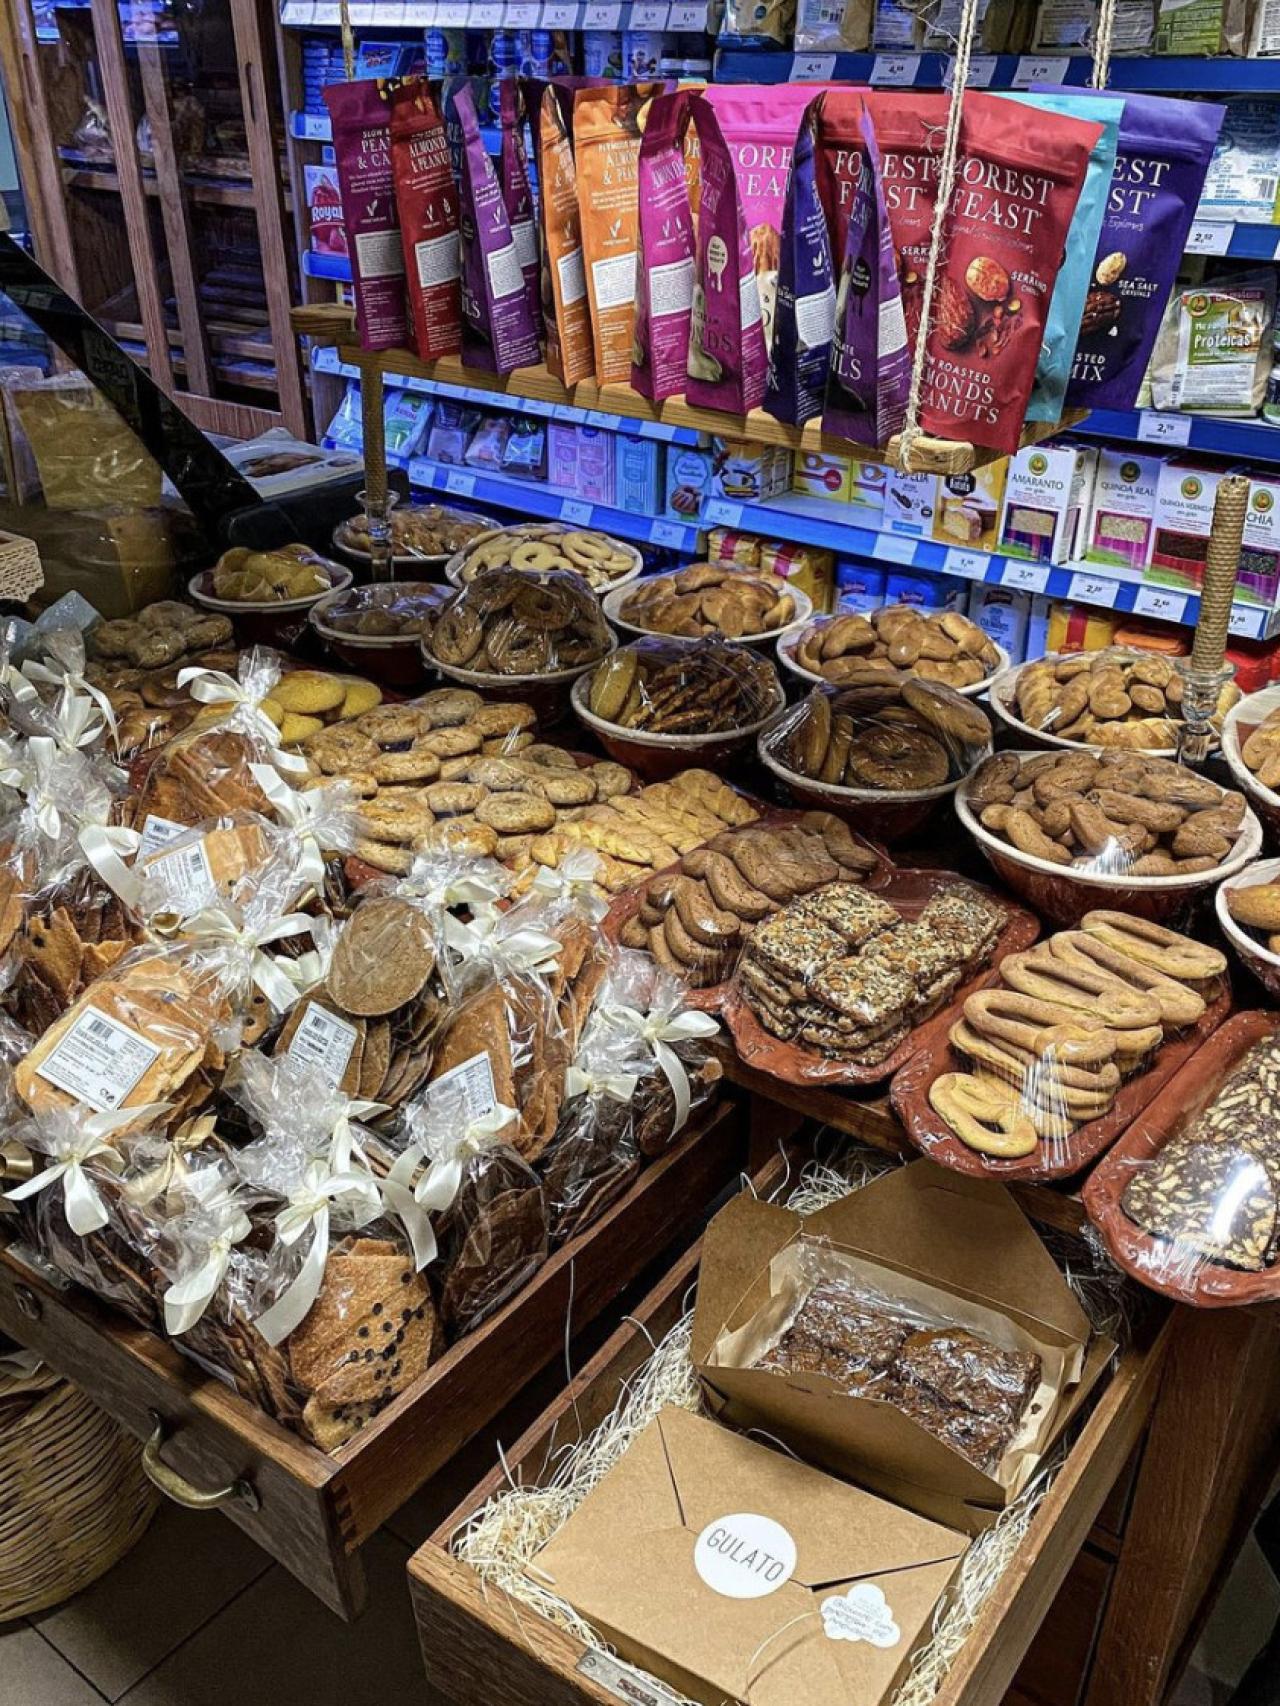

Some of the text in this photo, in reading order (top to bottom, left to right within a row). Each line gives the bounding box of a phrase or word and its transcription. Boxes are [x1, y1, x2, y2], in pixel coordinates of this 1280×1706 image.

[357, 155, 368, 171] &
[1111, 156, 1170, 188] EST
[962, 157, 1055, 206] OREST
[312, 206, 345, 222] Royal
[951, 187, 1041, 235] FEAST
[938, 359, 991, 384] ROASTED
[1011, 473, 1064, 490] AMARANTO
[1247, 512, 1273, 526] CHIA
[706, 1527, 784, 1582] GULATO
